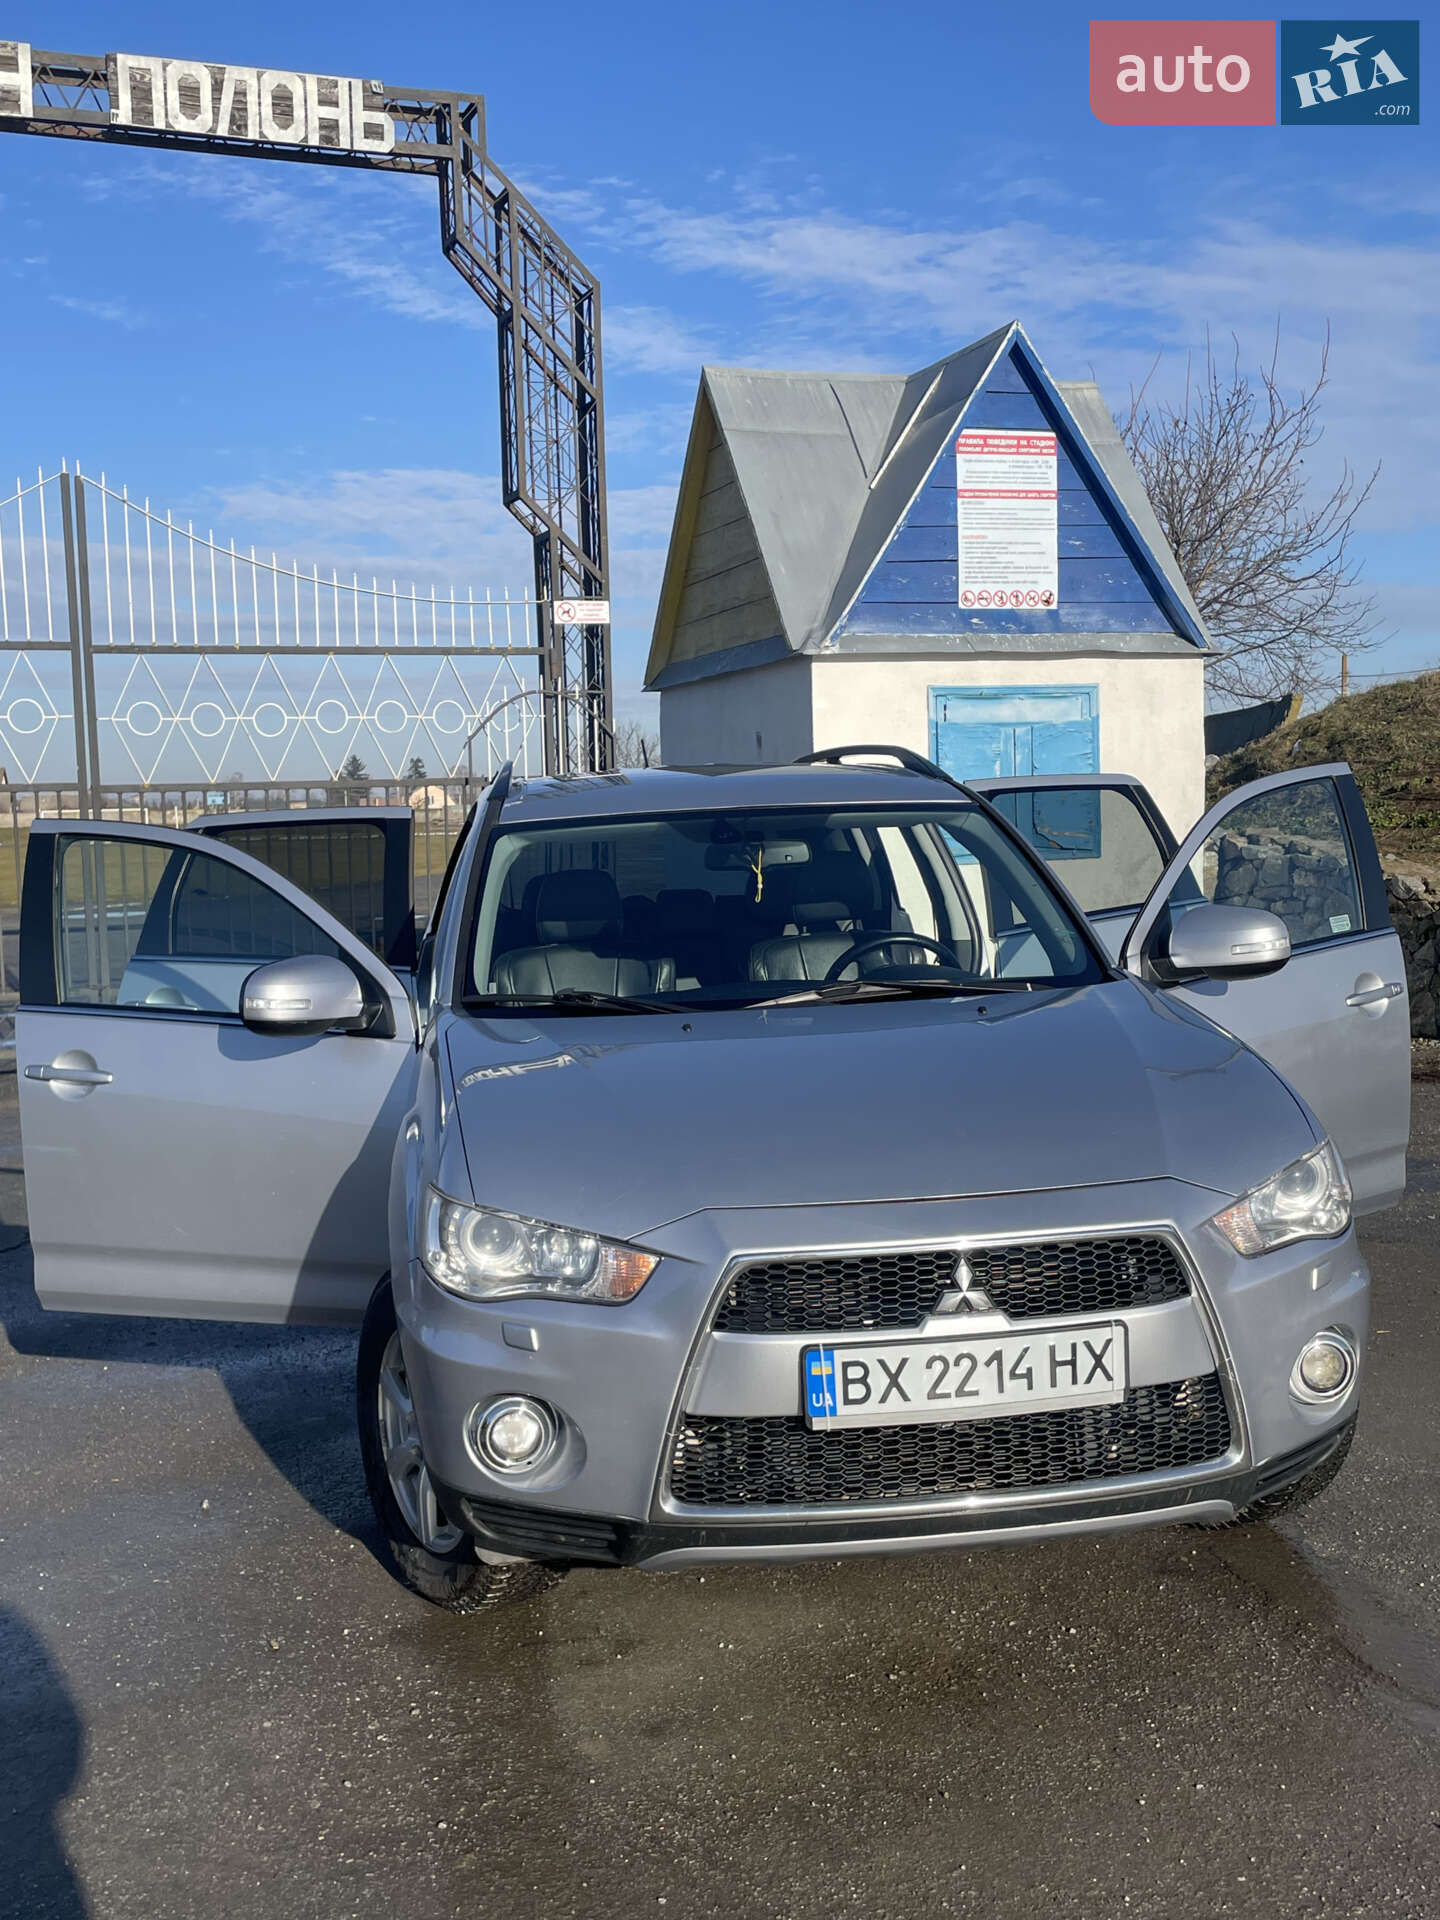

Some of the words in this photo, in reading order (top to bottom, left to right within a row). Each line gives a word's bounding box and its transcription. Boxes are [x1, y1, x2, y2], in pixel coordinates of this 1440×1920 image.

[116, 53, 396, 154] ПОЛОНЬ
[812, 1392, 834, 1407] UA
[924, 1345, 1034, 1400] 2214
